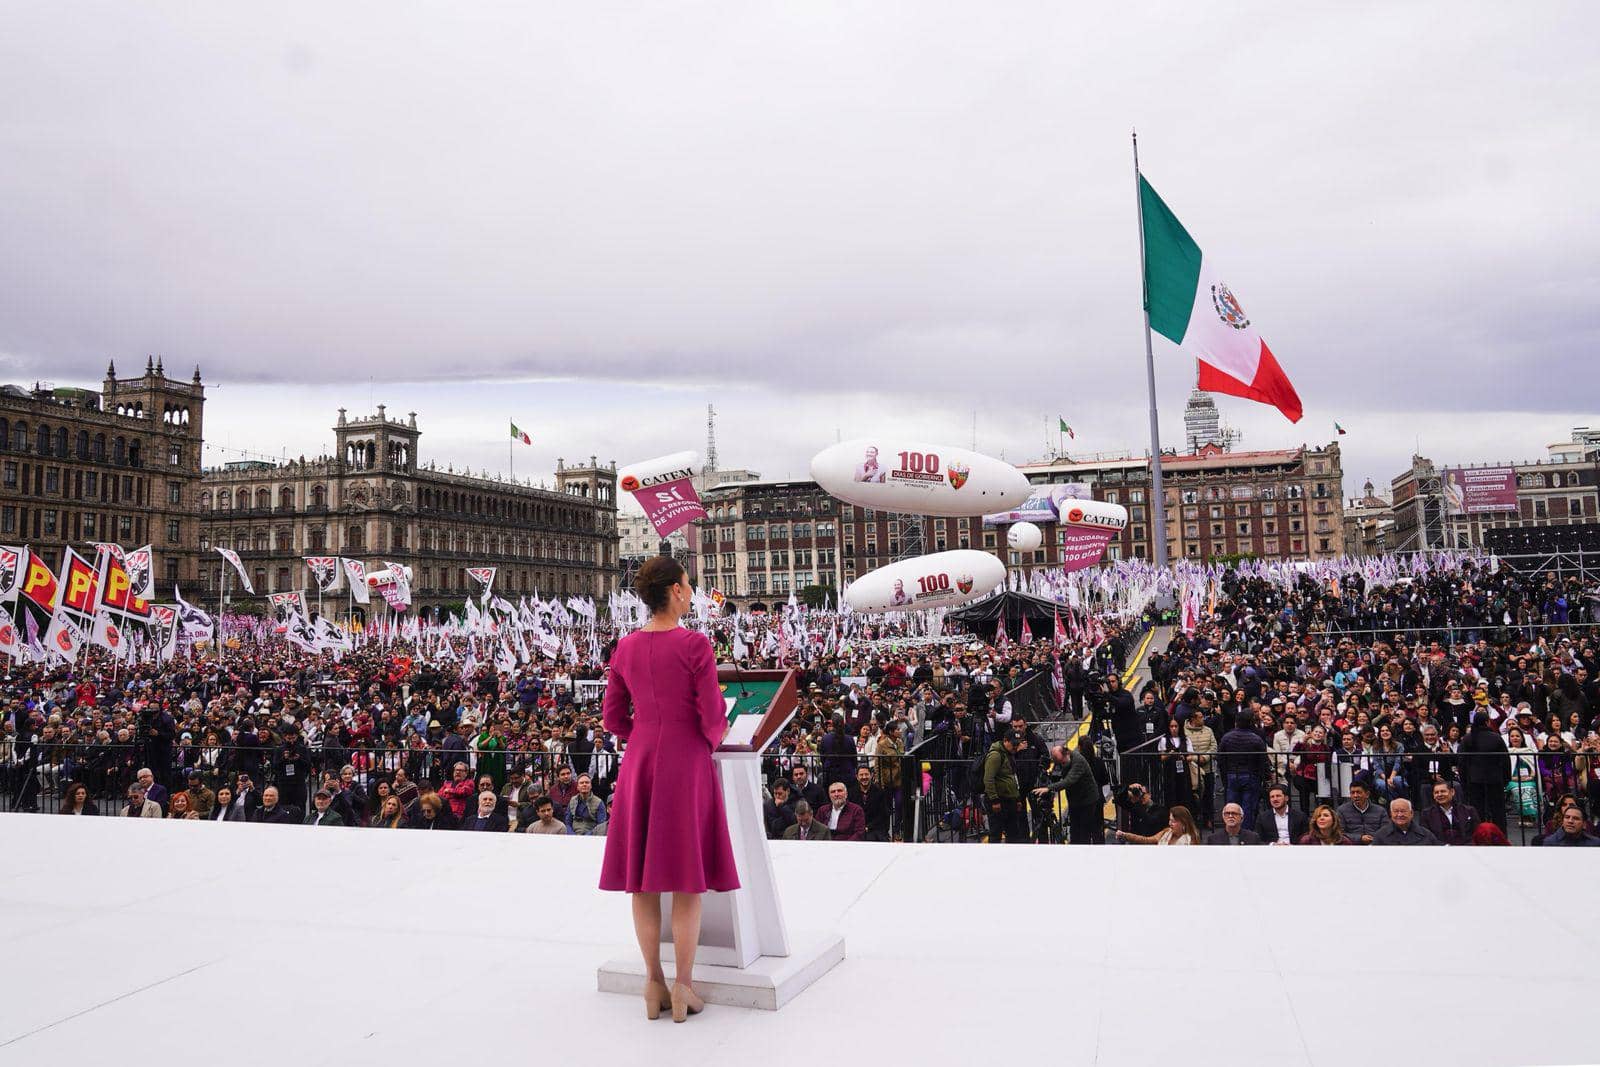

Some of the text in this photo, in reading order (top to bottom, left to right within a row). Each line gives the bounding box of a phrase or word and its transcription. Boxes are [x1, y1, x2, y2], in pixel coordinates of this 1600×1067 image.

[898, 451, 939, 473] 100
[642, 467, 694, 486] CATEM
[655, 505, 704, 526] DE VIVIEN
[657, 506, 668, 514] LA
[668, 500, 702, 509] REFORM
[1083, 513, 1126, 528] CATEM
[1065, 554, 1080, 562] 100
[917, 573, 949, 592] 100
